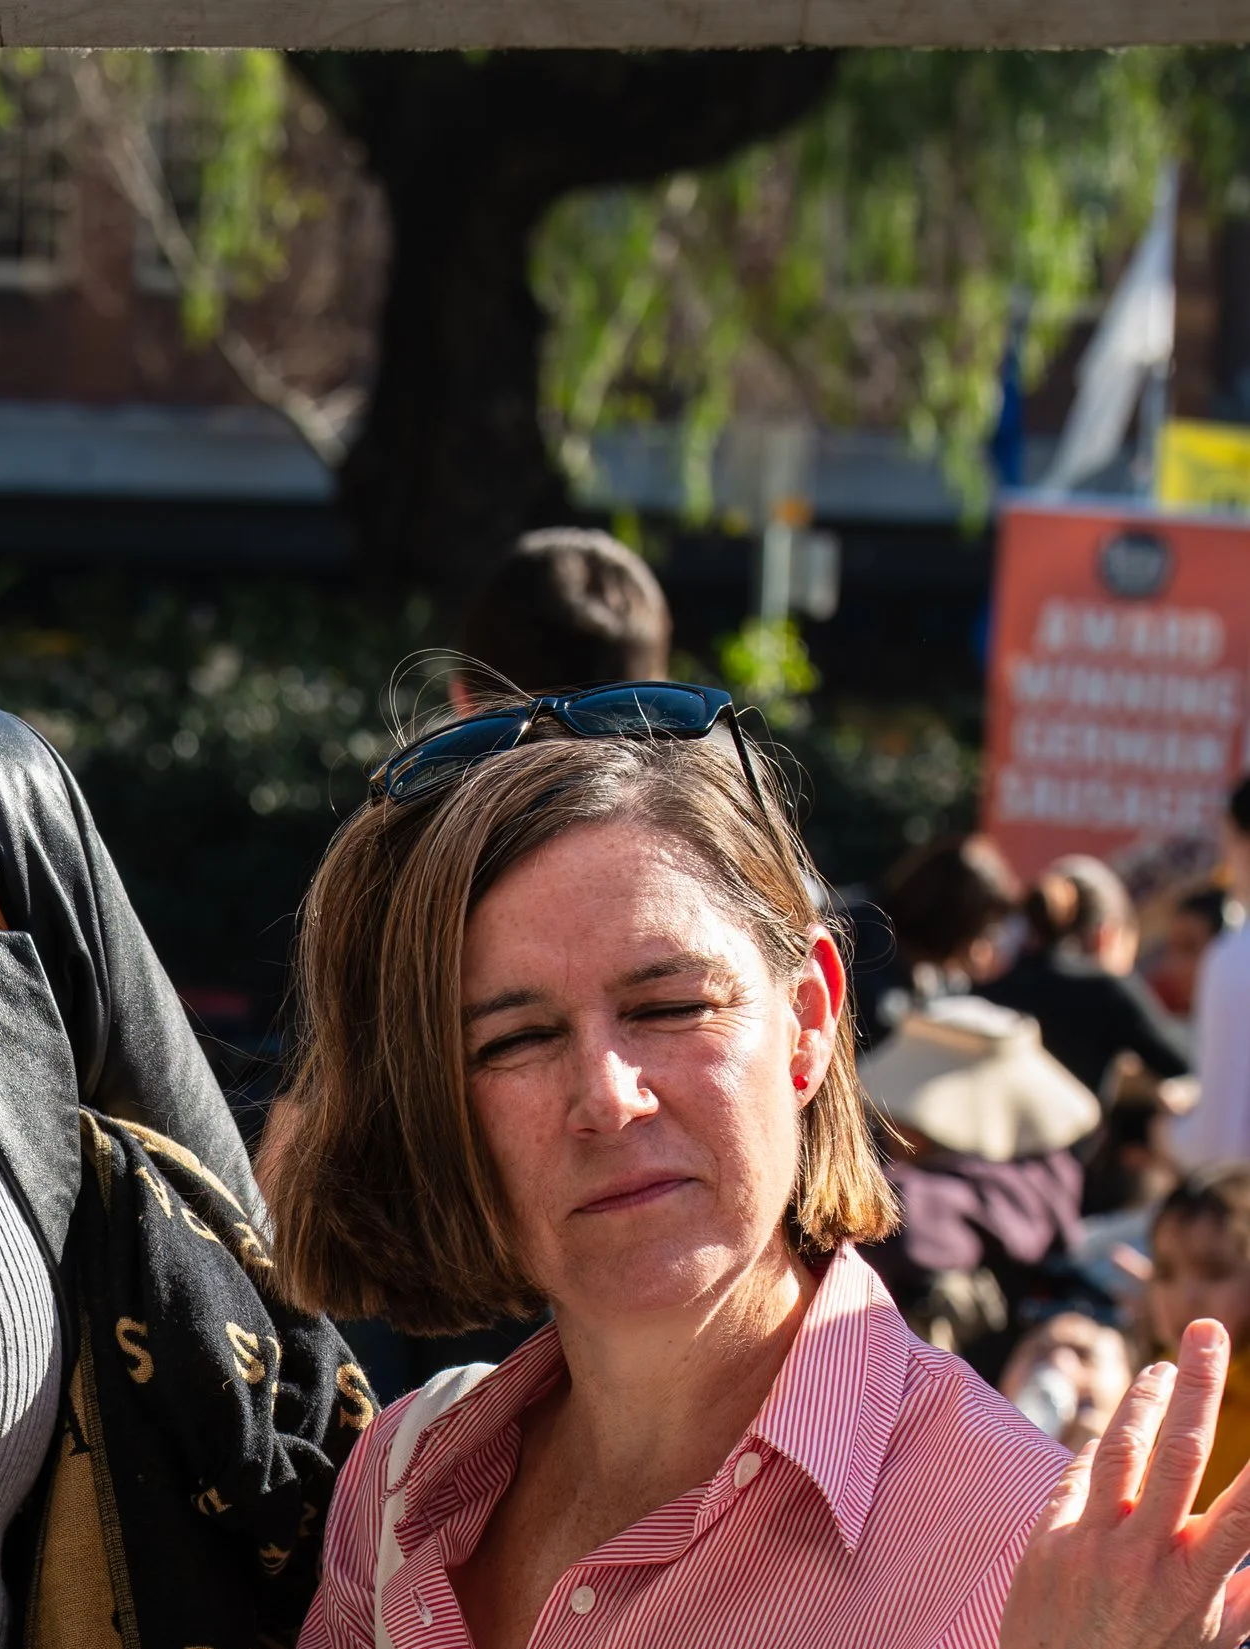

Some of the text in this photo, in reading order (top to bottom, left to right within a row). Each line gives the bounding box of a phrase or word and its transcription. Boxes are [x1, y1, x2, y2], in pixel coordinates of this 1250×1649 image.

[1036, 598, 1224, 666] AWARD
[1008, 656, 1239, 722] WINNING
[1013, 718, 1224, 772] GERMAN
